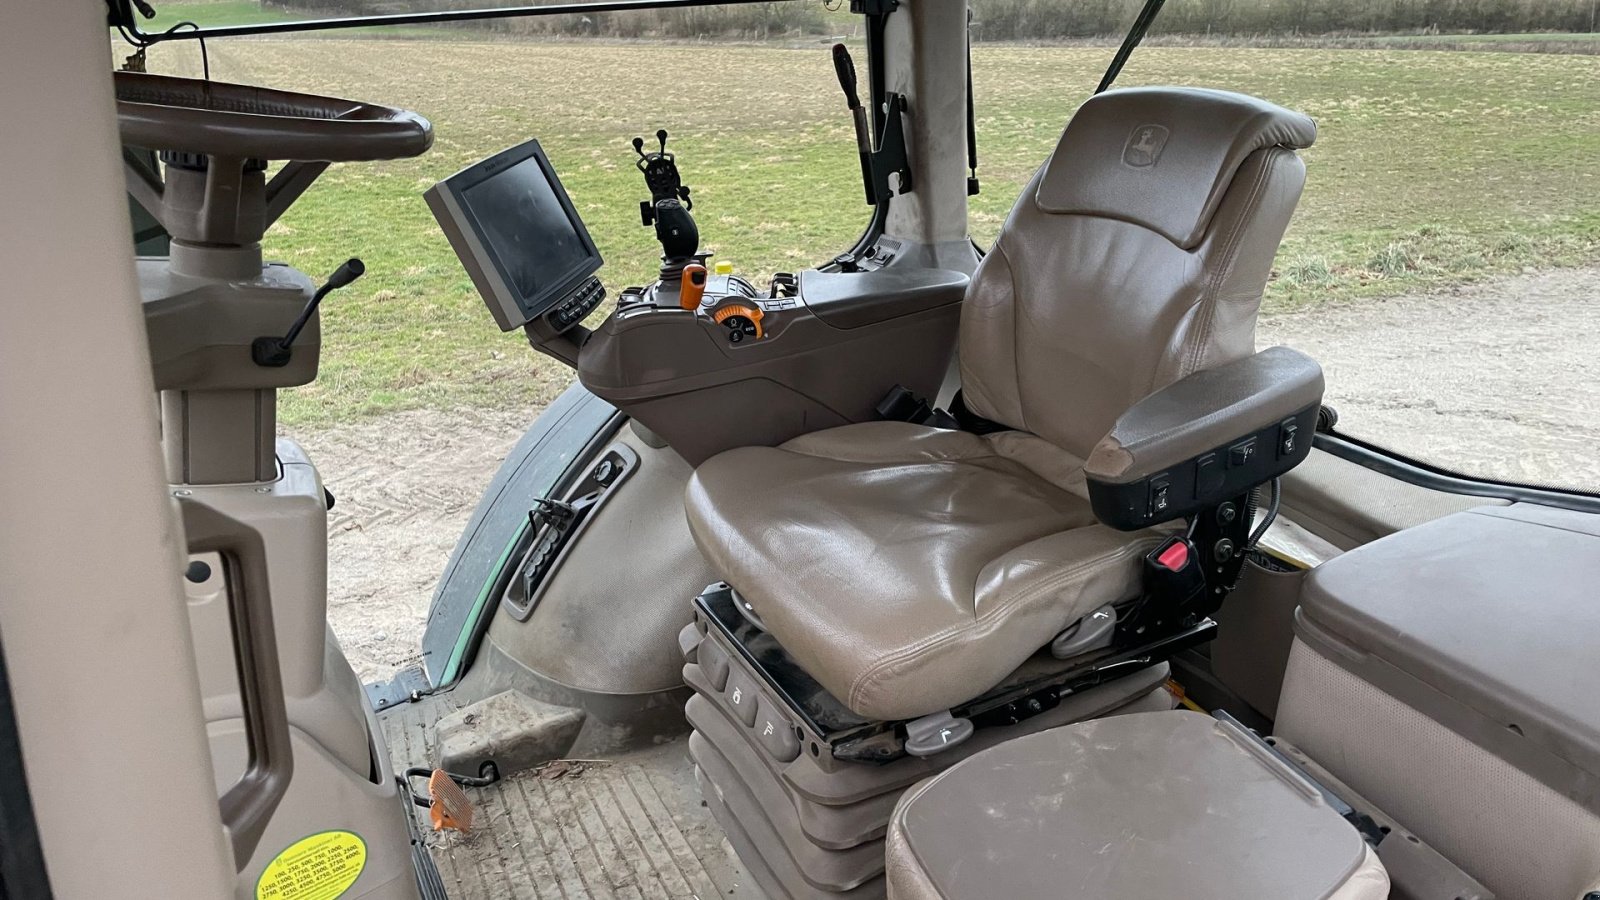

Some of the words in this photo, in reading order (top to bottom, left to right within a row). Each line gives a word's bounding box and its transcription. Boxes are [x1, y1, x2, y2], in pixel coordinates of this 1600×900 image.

[262, 883, 277, 892] 1250,
[277, 876, 293, 885] 1500,
[294, 868, 310, 877] 1750,
[310, 860, 327, 870] 2000,
[327, 852, 342, 862] 2250,
[344, 845, 358, 854] 2500,
[263, 890, 278, 899] 2750,
[279, 882, 295, 892] 3000,
[297, 874, 312, 883] 3250,
[313, 866, 329, 876] 3500,
[330, 858, 345, 867] 3750,
[346, 850, 360, 859] 4000,
[275, 871, 287, 879] 100,
[288, 865, 300, 873] 250,
[301, 859, 314, 867] 500,
[328, 845, 343, 854] 1000,
[300, 879, 315, 888] 4500,
[316, 872, 332, 880] 4750,
